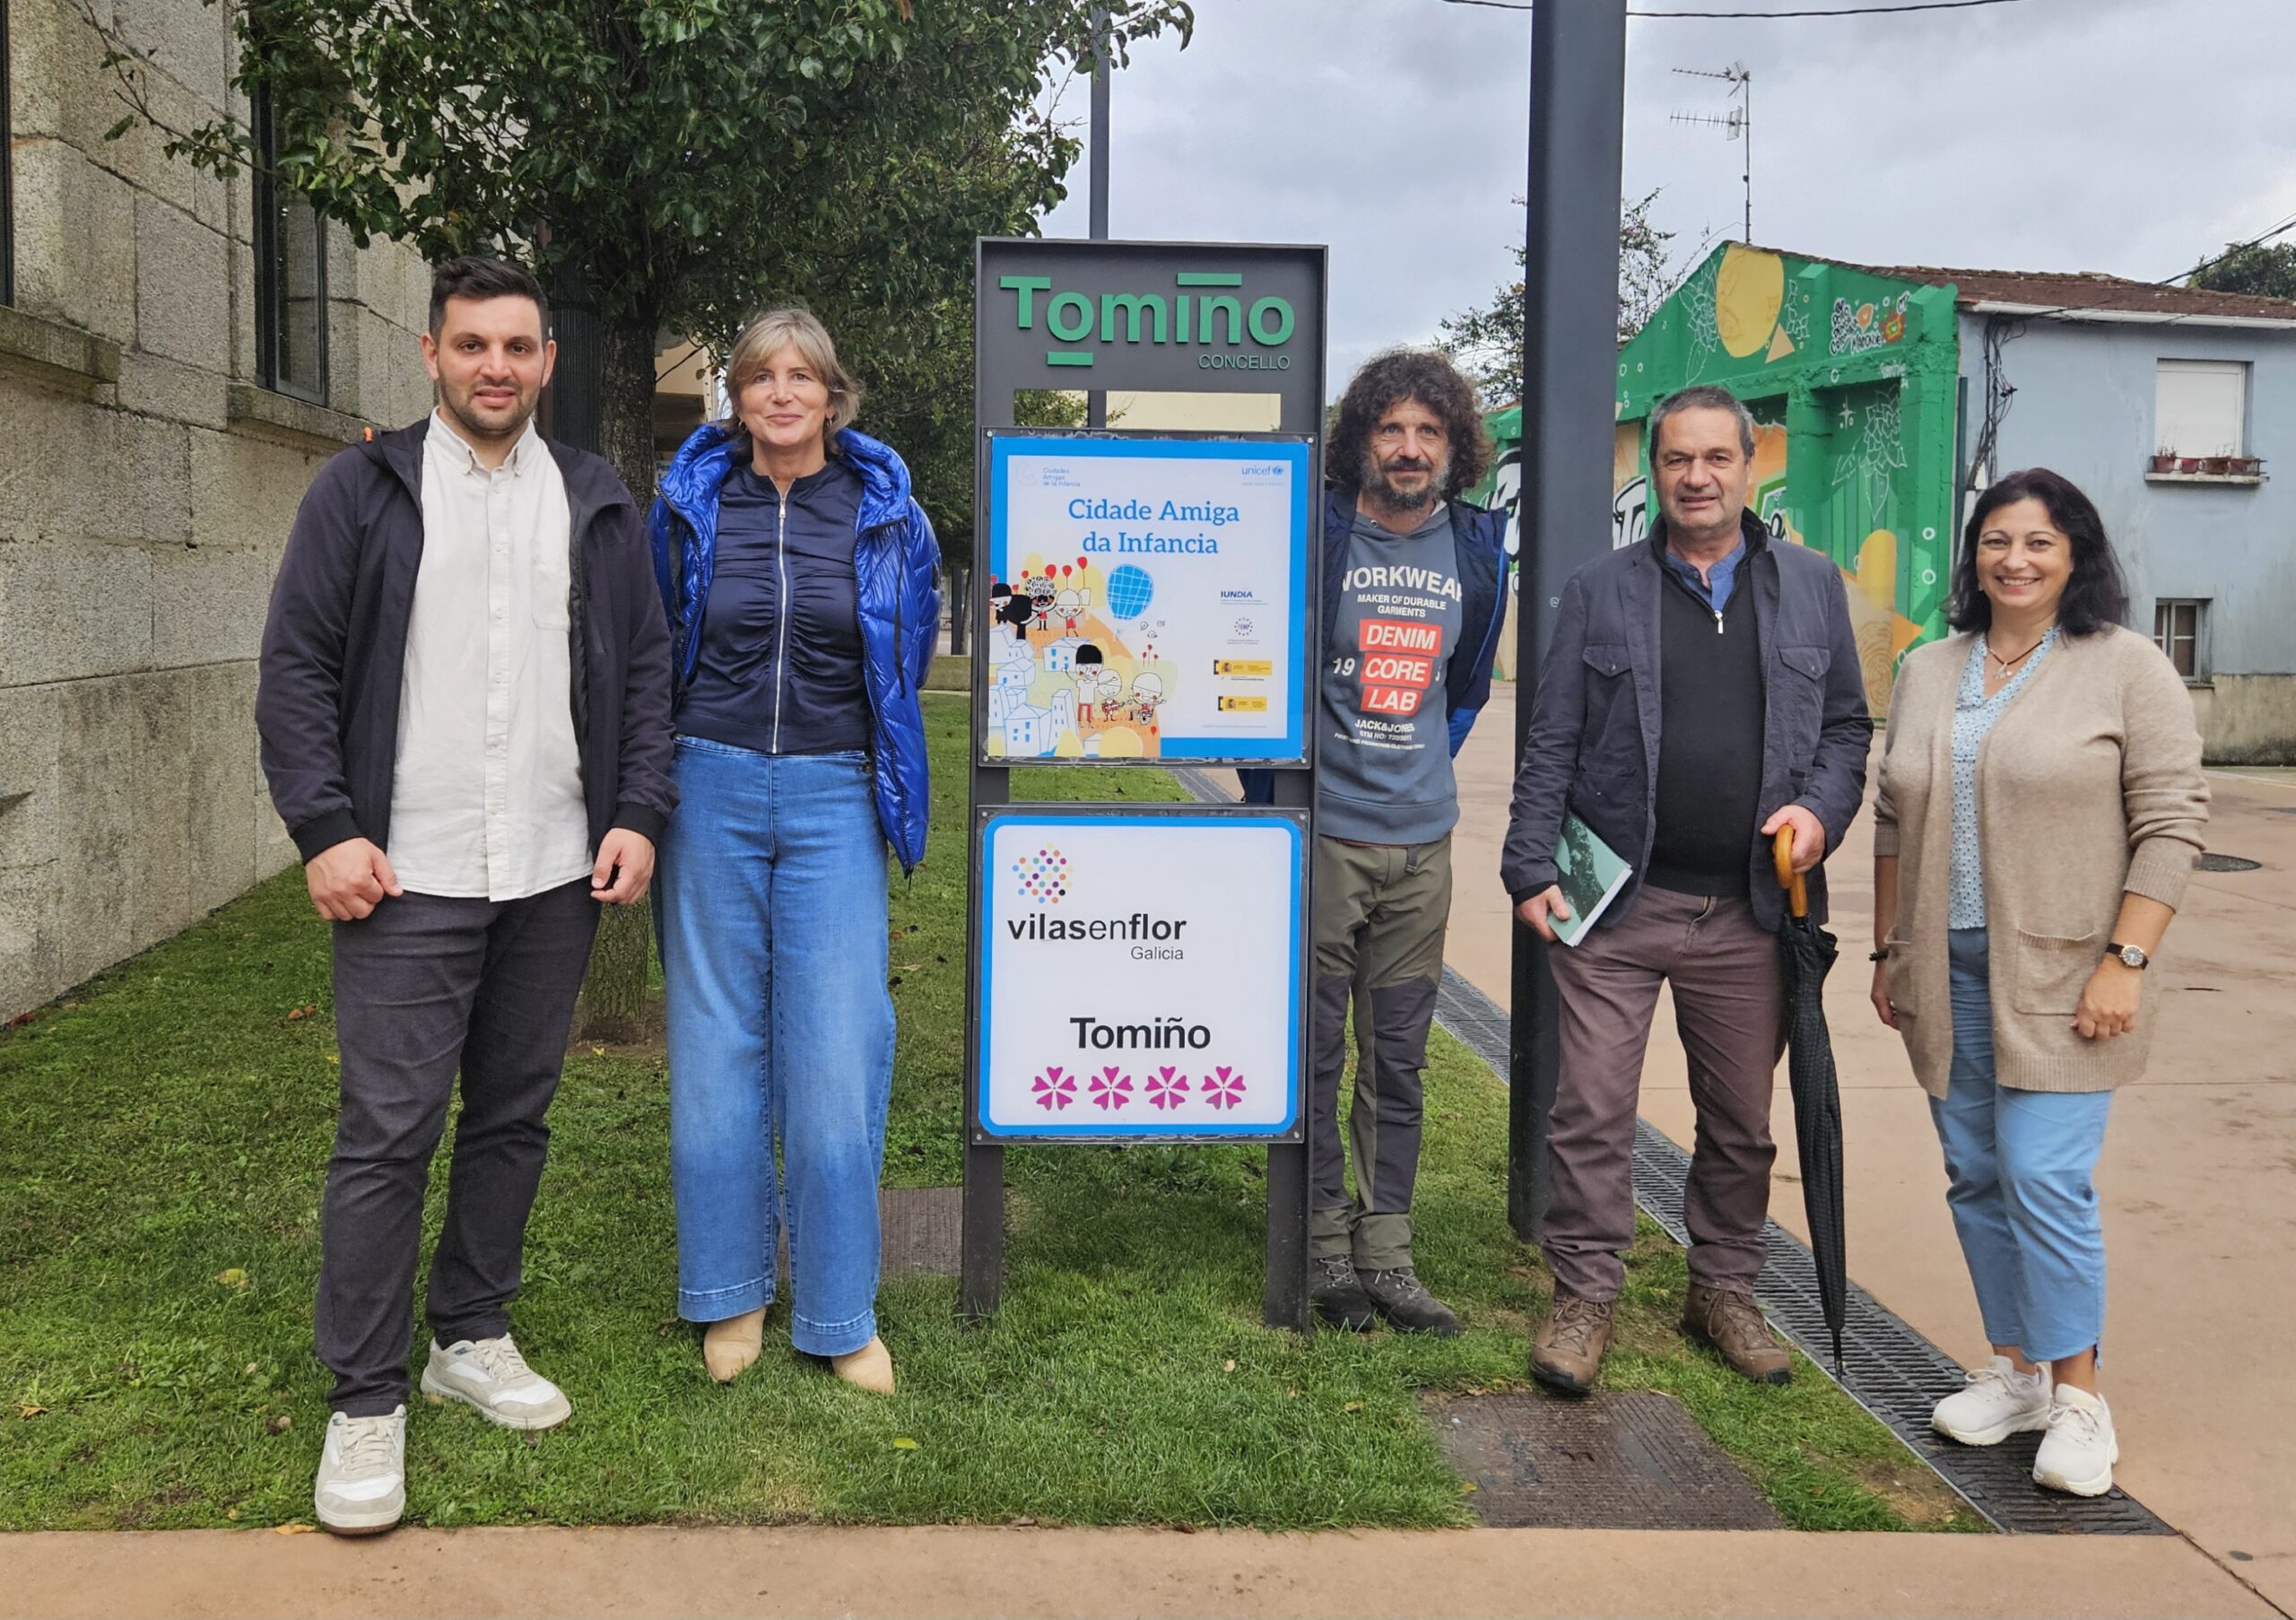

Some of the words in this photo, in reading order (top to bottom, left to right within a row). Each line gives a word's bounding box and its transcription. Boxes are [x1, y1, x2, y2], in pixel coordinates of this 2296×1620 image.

[1197, 353, 1291, 370] CONCELLO
[1241, 465, 1272, 475] unicef
[1068, 499, 1152, 521] Cidade
[1158, 500, 1240, 526] Amiga
[1082, 533, 1111, 553] da
[1118, 532, 1219, 554] Infancia
[1220, 590, 1253, 598] IUNDIA
[1357, 594, 1390, 604] MAKER
[1391, 595, 1404, 605] OF
[1403, 597, 1447, 611] DURABLE
[1378, 605, 1426, 618] GARMENTS
[1366, 624, 1437, 650] DENIM
[1333, 657, 1356, 676] 19
[1365, 658, 1429, 682] CORE
[1368, 689, 1418, 711] LAB
[1354, 719, 1415, 734] JACK&JONES
[1006, 912, 1187, 941] vilasenflor
[1130, 945, 1184, 961] Galicia
[1069, 1016, 1212, 1050] Tomiño
